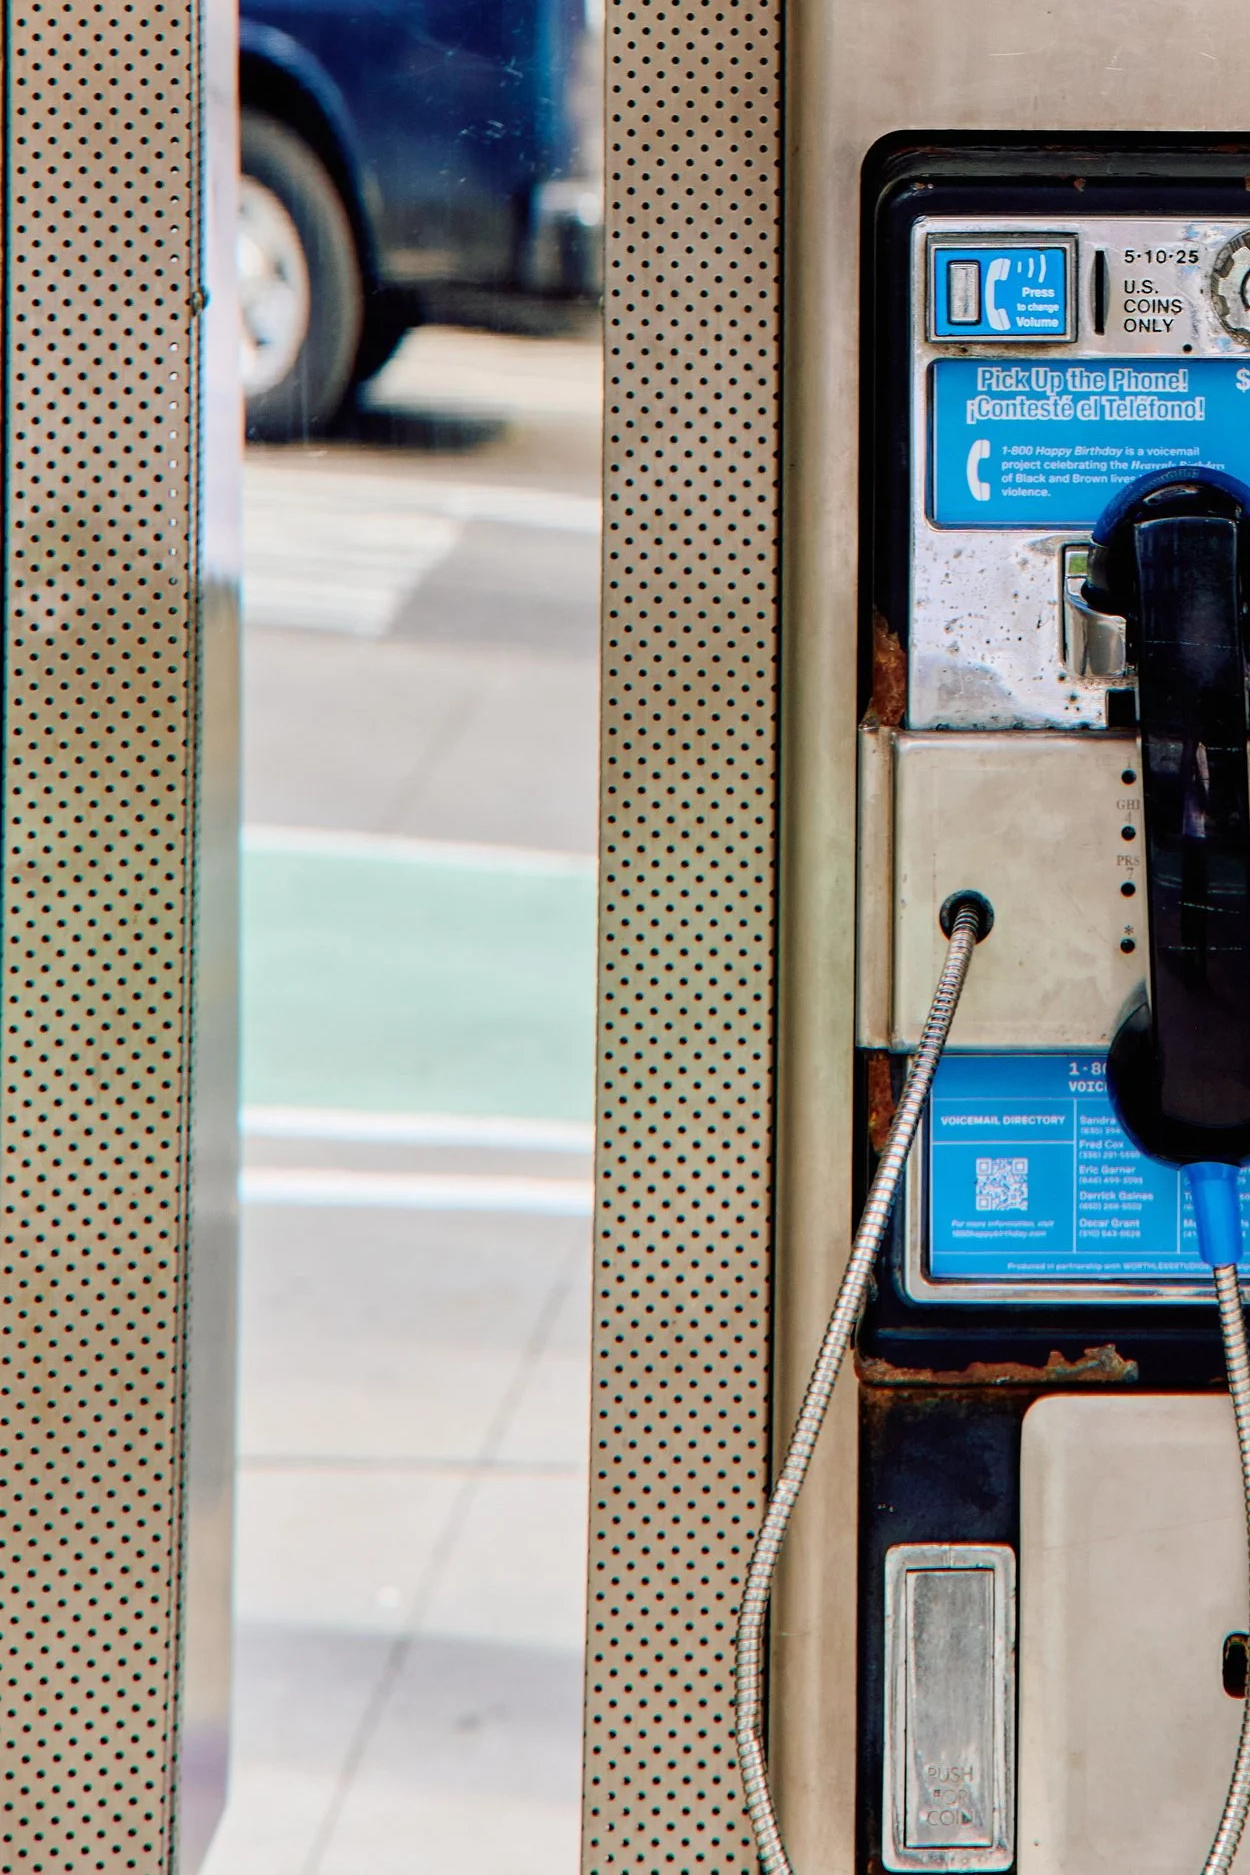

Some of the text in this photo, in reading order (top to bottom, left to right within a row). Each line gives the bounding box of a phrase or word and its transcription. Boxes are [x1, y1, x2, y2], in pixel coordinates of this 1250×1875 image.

[1022, 287, 1055, 298] Press
[1124, 280, 1159, 294] U.S.
[1017, 303, 1059, 313] to change
[1124, 299, 1183, 314] COINS
[1016, 317, 1059, 328] Volume
[1124, 318, 1174, 333] ONLY
[977, 367, 1189, 396] Pick Up the Phone!
[1077, 397, 1101, 420] el
[1102, 395, 1205, 421] Teléfono!
[1001, 446, 1200, 458] 1-800 Happy Birthday is a voicemail
[1001, 461, 1041, 472] project
[1043, 460, 1108, 472] celebrating
[1109, 460, 1129, 470] the
[1001, 473, 1136, 484] of Black and Brown lives
[1001, 487, 1051, 497] violence.
[1116, 855, 1140, 866] PRS
[941, 1115, 1066, 1125] VOICEMAIL DIRECTORY
[1080, 1115, 1117, 1125] Sandra
[1079, 1140, 1124, 1149] Fred Cox
[1079, 1165, 1099, 1174] Eric
[1111, 1218, 1140, 1227] Grant
[928, 1766, 973, 1782] PUSH
